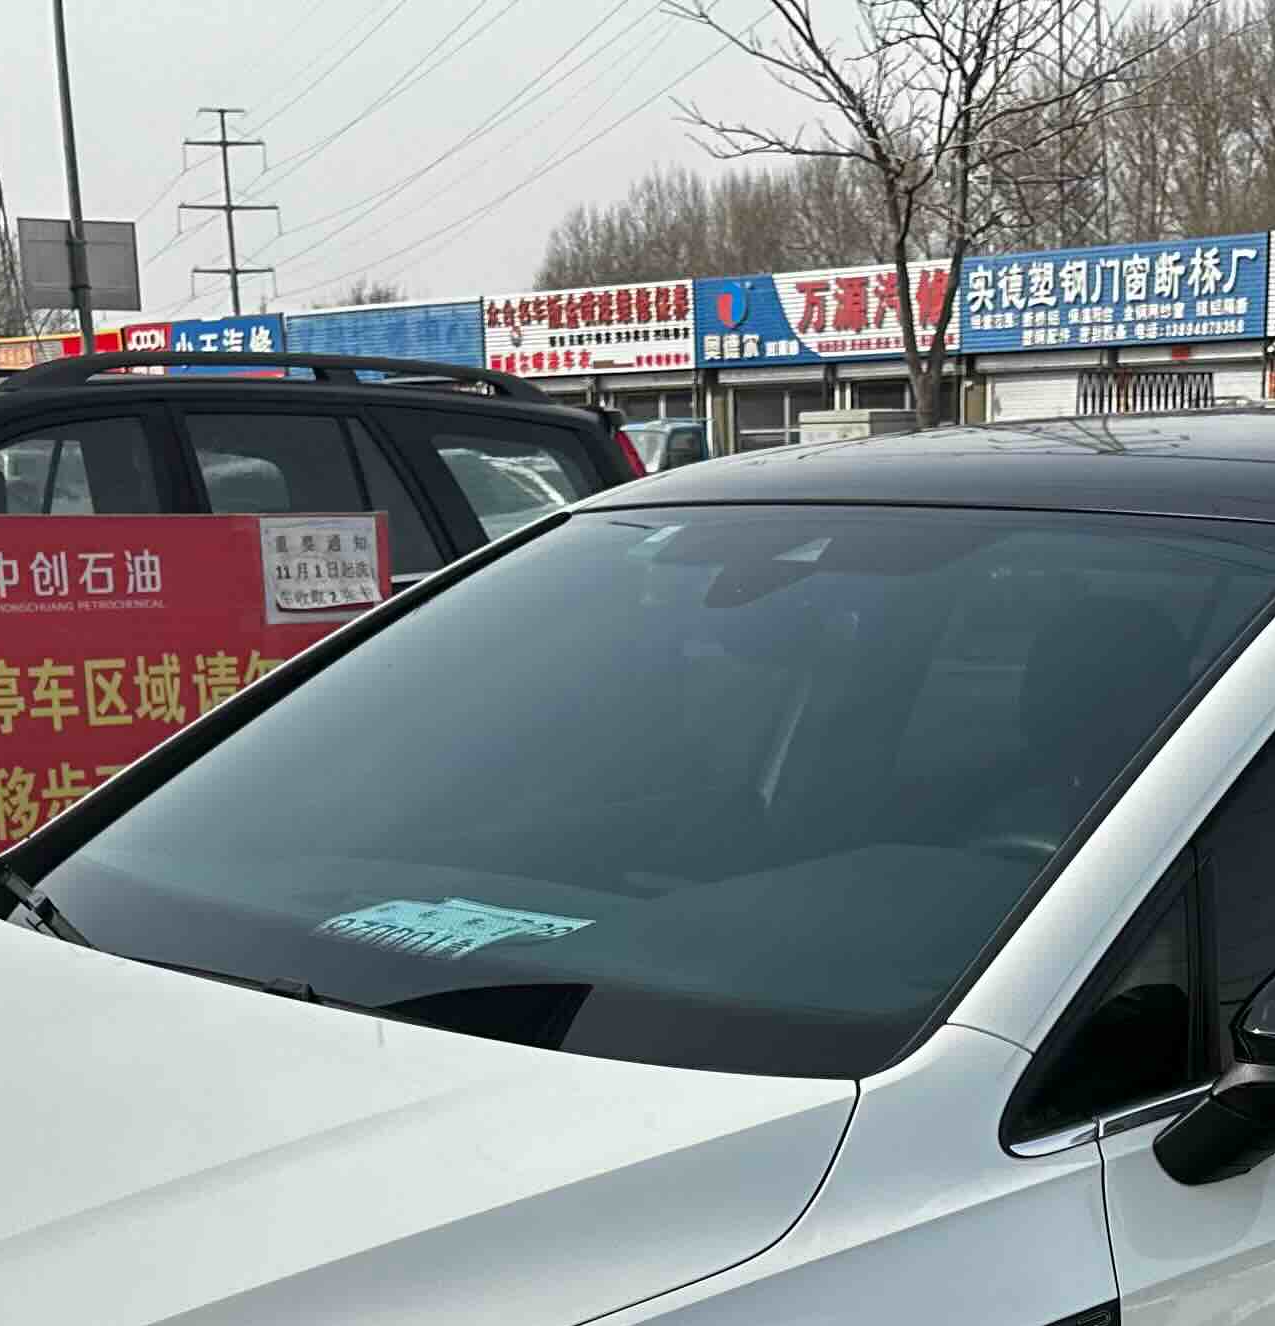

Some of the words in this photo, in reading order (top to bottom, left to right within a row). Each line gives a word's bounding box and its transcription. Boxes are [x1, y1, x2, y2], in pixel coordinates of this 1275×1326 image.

[795, 268, 950, 334] 万源汽修
[967, 247, 1257, 312] 实德塑钢门窗断桥厂
